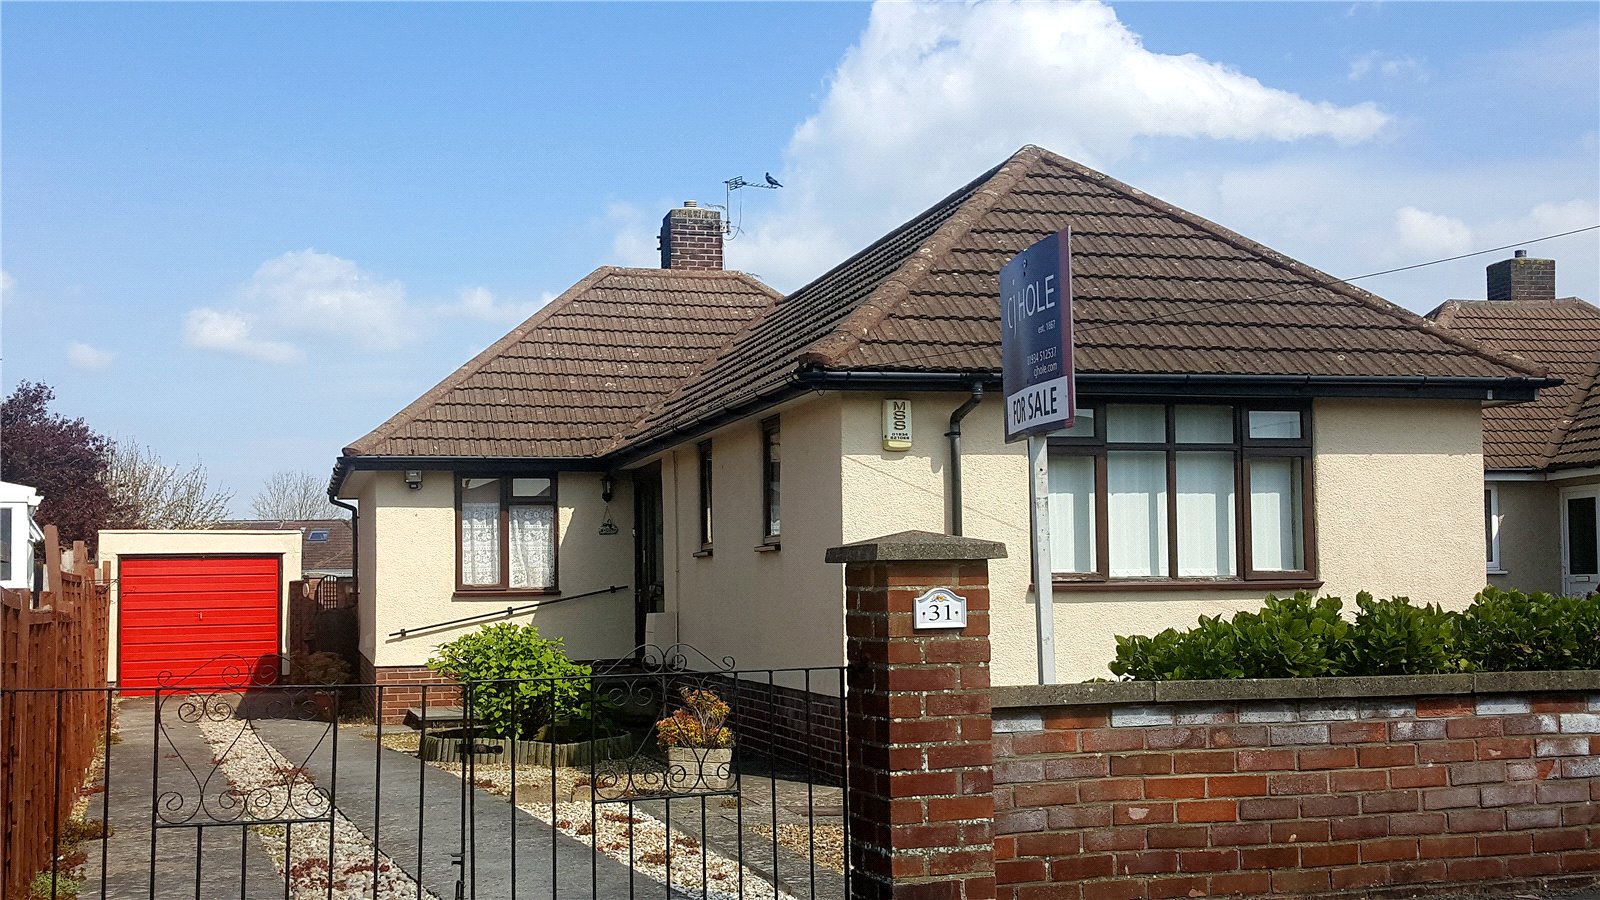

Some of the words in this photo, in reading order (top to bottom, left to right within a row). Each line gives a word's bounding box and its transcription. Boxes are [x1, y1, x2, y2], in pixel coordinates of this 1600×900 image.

[1018, 274, 1056, 321] HOLE
[1046, 319, 1056, 331] 1867
[1026, 352, 1040, 365] 01934
[1033, 362, 1058, 379] cjhole.com
[1013, 396, 1026, 426] FOR
[1028, 386, 1058, 420] SALE
[929, 604, 952, 621] 31
